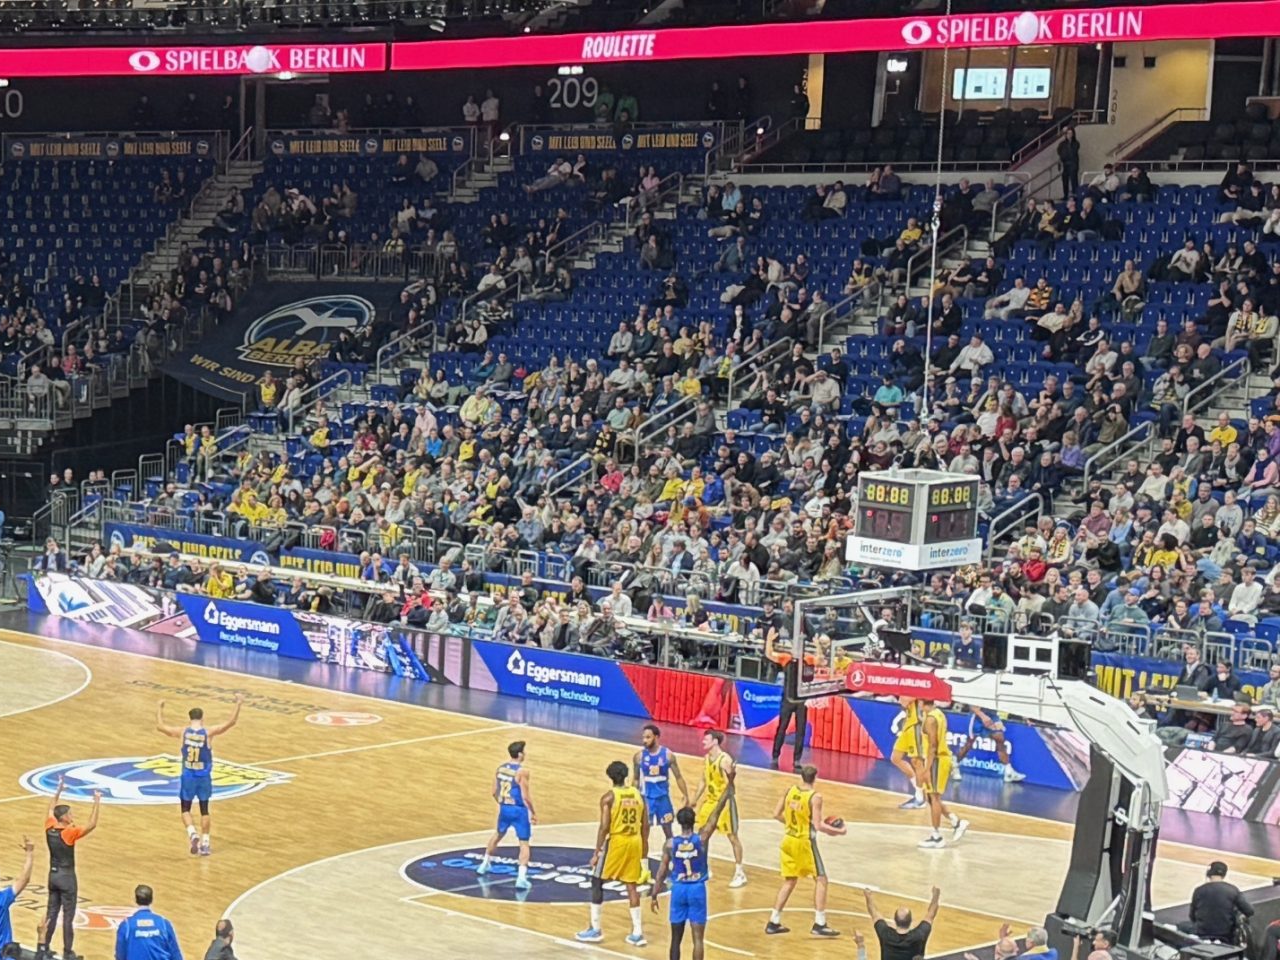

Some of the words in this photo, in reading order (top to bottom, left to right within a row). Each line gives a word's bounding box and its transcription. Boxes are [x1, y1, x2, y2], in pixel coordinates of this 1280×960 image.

[937, 16, 1052, 44] SPIELBAK
[1062, 10, 1143, 39] BERLIN
[582, 33, 656, 58] ROULETTE
[165, 48, 280, 72] SPIELBAK
[290, 47, 366, 69] BERLIN
[547, 77, 599, 108] 209
[249, 337, 332, 357] ALBA
[190, 354, 217, 370] WIR
[219, 365, 255, 384] SIND
[860, 541, 903, 557] interzero
[930, 546, 969, 559] interzero
[219, 612, 280, 635] Eggersmann
[246, 635, 280, 651] Technology
[527, 662, 601, 688] Eggersmann
[867, 675, 899, 685] TURKISH
[900, 678, 932, 688] AIRLINES
[526, 683, 559, 700] Recycling
[560, 687, 600, 706] Technology
[187, 746, 200, 762] 31
[621, 808, 637, 824] 33
[683, 859, 692, 876] 1
